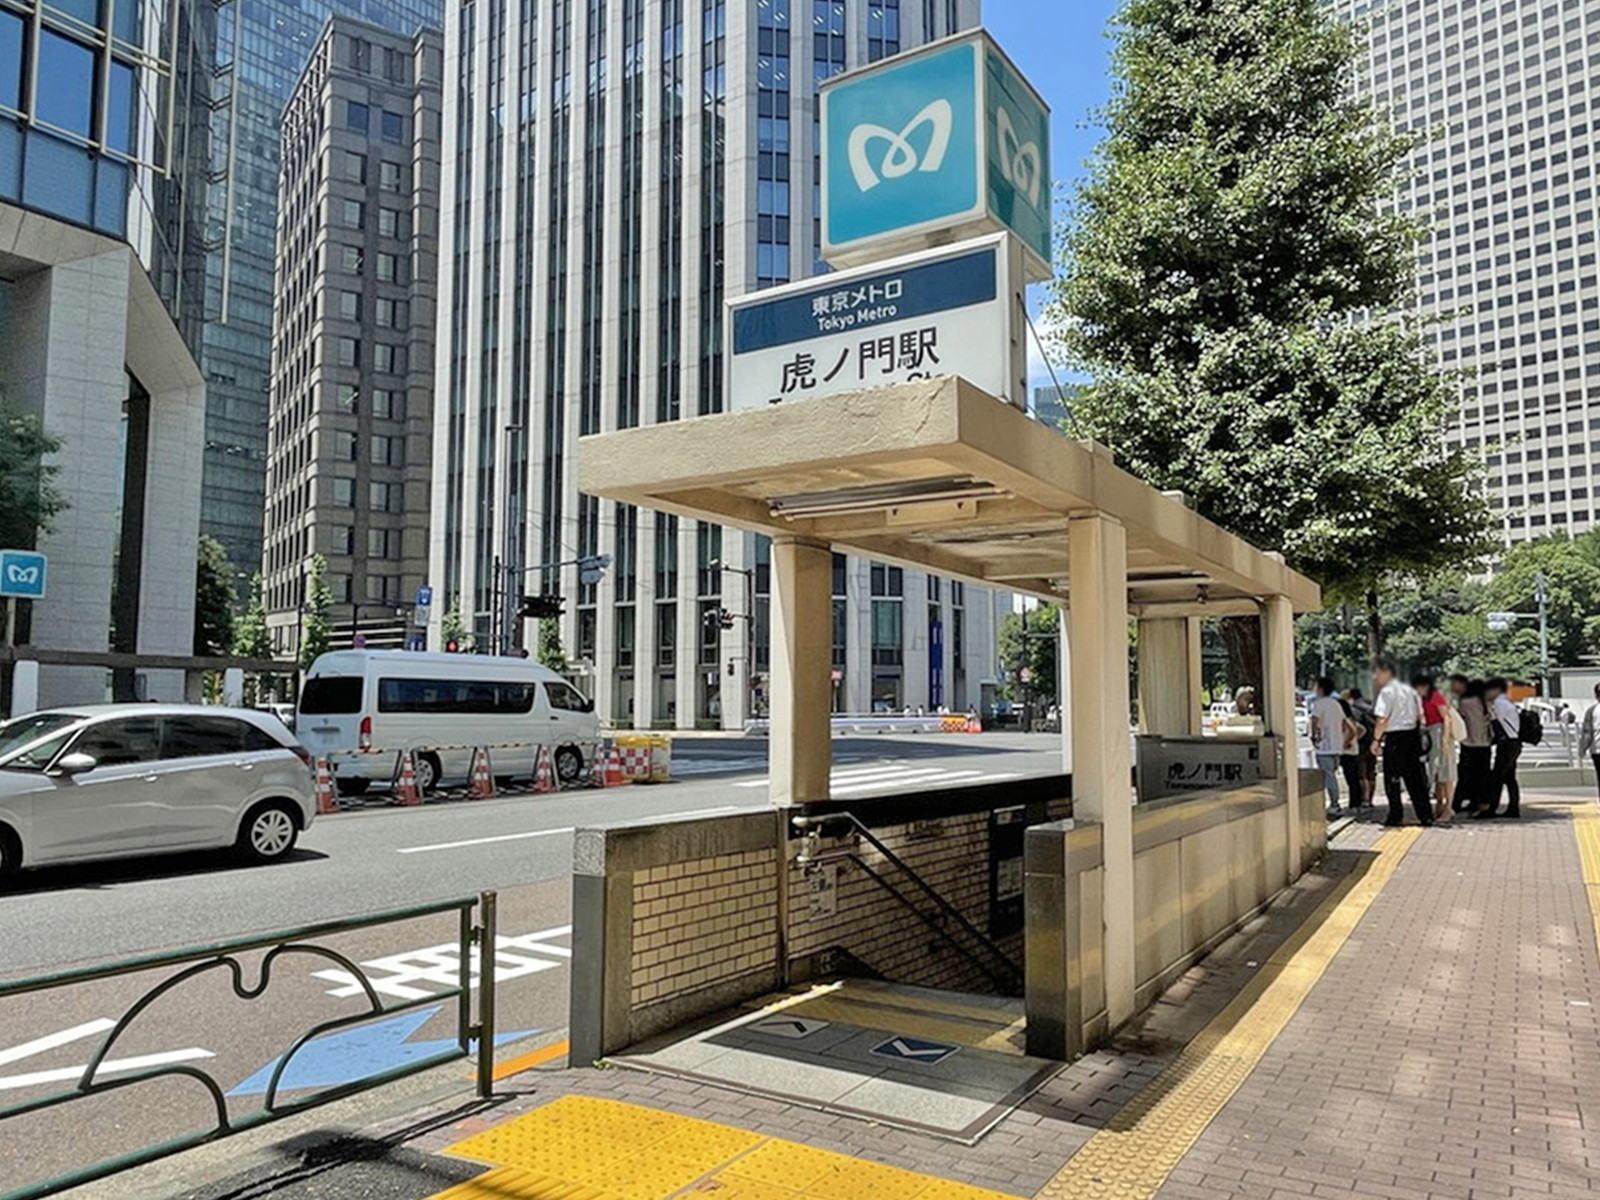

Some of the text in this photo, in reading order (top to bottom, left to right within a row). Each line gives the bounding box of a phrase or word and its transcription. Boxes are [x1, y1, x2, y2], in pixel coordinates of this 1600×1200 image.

[811, 278, 903, 317] 東京メトロ
[817, 304, 897, 331] Tokyo Metro
[780, 326, 940, 394] 虎ノ門駅
